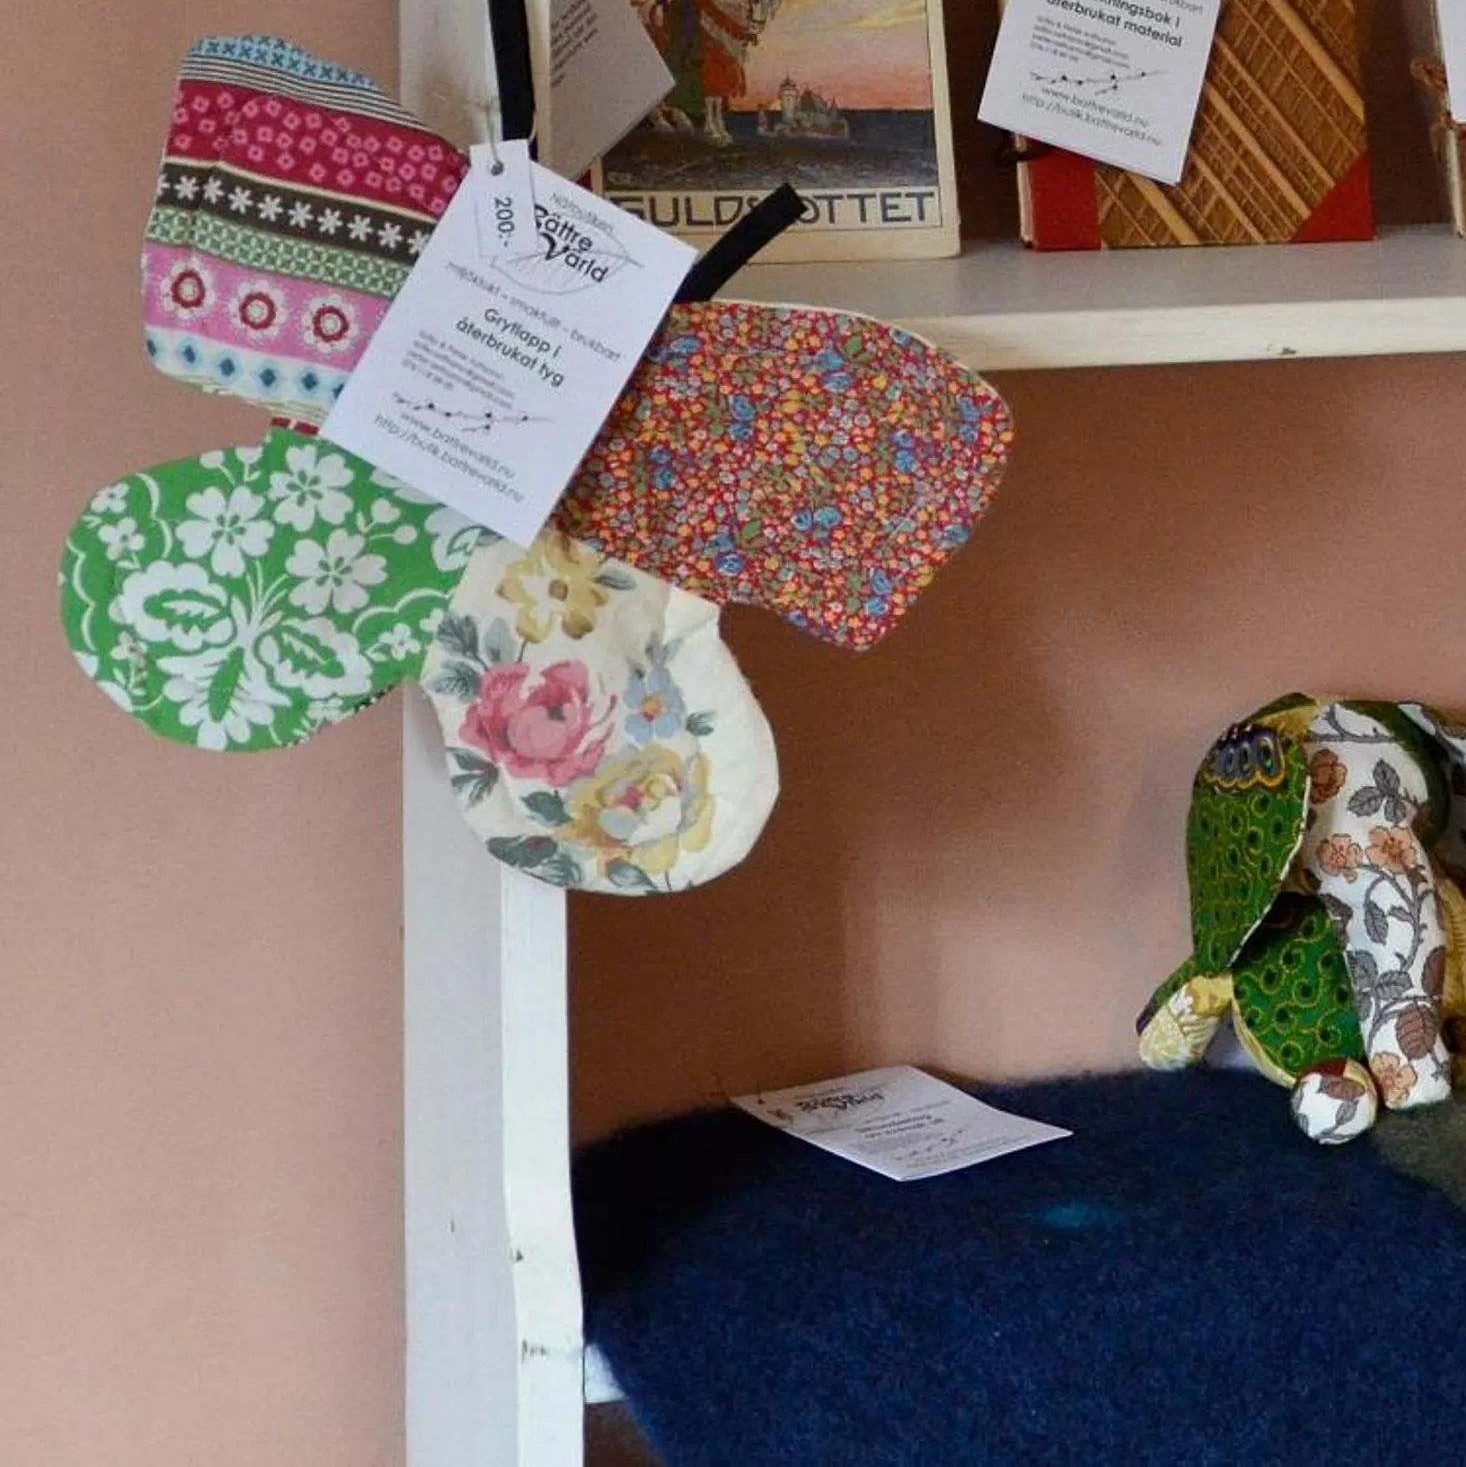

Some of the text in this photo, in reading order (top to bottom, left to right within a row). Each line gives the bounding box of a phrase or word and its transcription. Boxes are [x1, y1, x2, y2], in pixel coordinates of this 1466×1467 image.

[1124, 19, 1183, 48] material
[539, 232, 609, 283] Värld
[456, 318, 540, 375] återbrukat
[537, 360, 565, 388] tyg
[483, 307, 558, 357] Grytlapp
